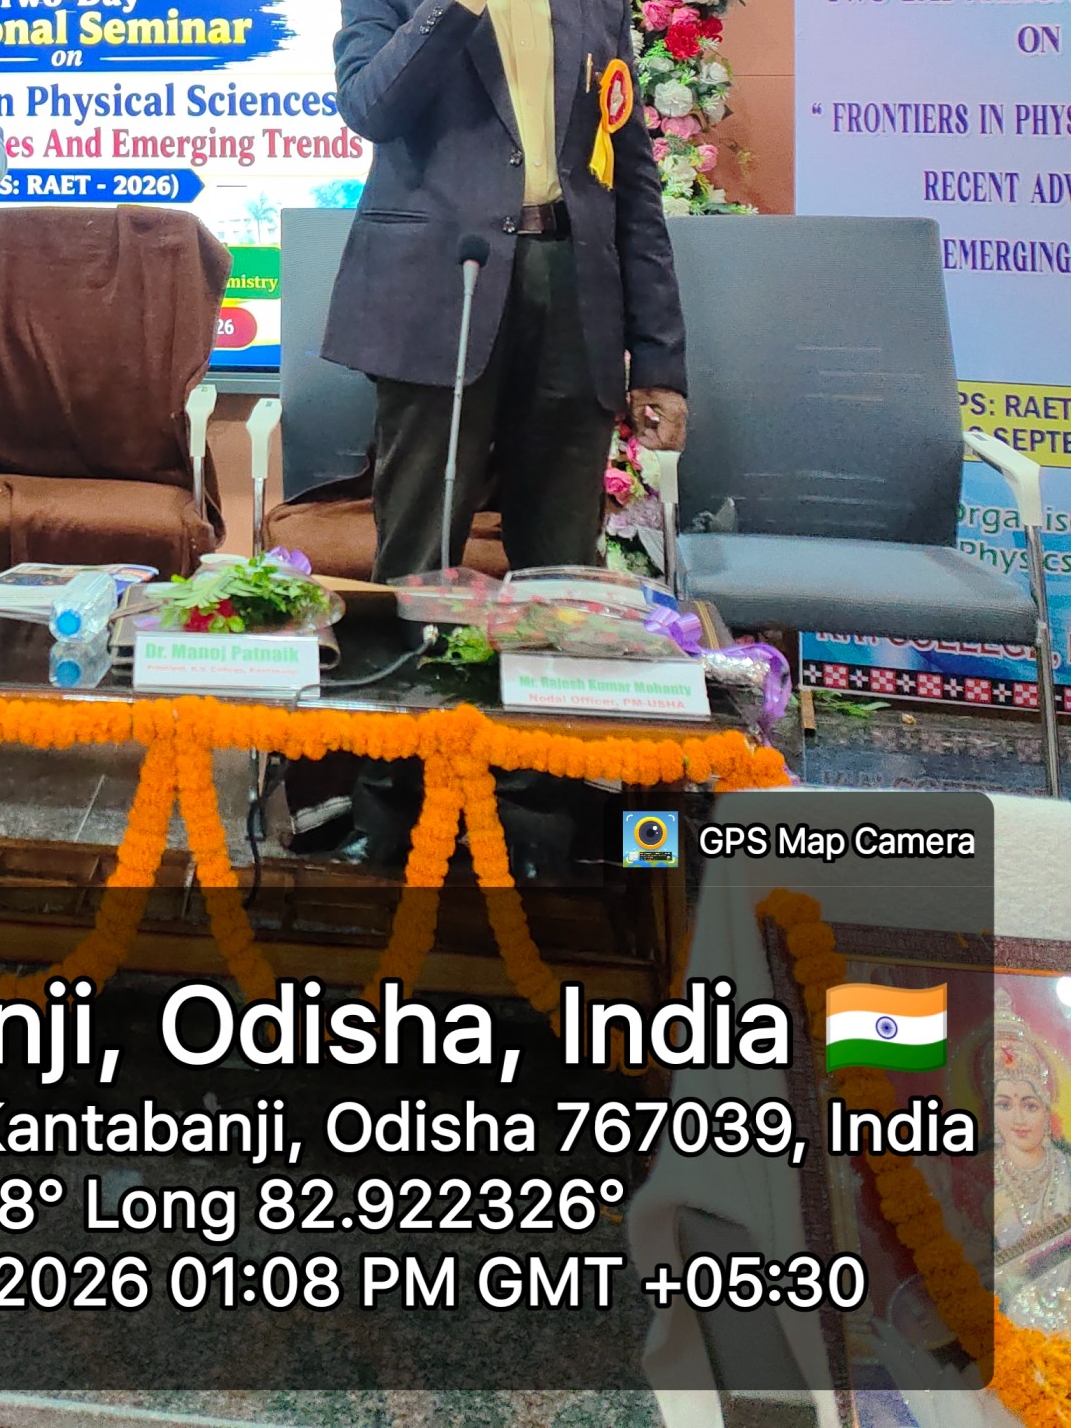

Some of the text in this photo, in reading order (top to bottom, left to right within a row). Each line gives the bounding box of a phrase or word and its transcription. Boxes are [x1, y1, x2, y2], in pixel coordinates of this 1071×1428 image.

[79, 8, 252, 45] Seminar
[1018, 25, 1061, 54] ON
[51, 47, 83, 67] on
[26, 82, 175, 126] Physical
[187, 82, 337, 117] Sciences
[833, 102, 969, 135] FRONTIERS
[979, 103, 1004, 135] IN
[43, 127, 102, 159] And
[112, 127, 256, 168] Emerging
[262, 127, 363, 159] Trends
[27, 174, 90, 196] RAET
[113, 174, 180, 198] 2026)
[923, 171, 1020, 203] RECENT
[942, 239, 1071, 274] EMERGING
[145, 643, 299, 663] Dr. Manoj Patnaik
[529, 693, 685, 709] Nodal Officer, PM-USHA
[541, 676, 586, 691] Rajesh
[588, 679, 631, 693] Kumar
[634, 682, 692, 697] Mohanty
